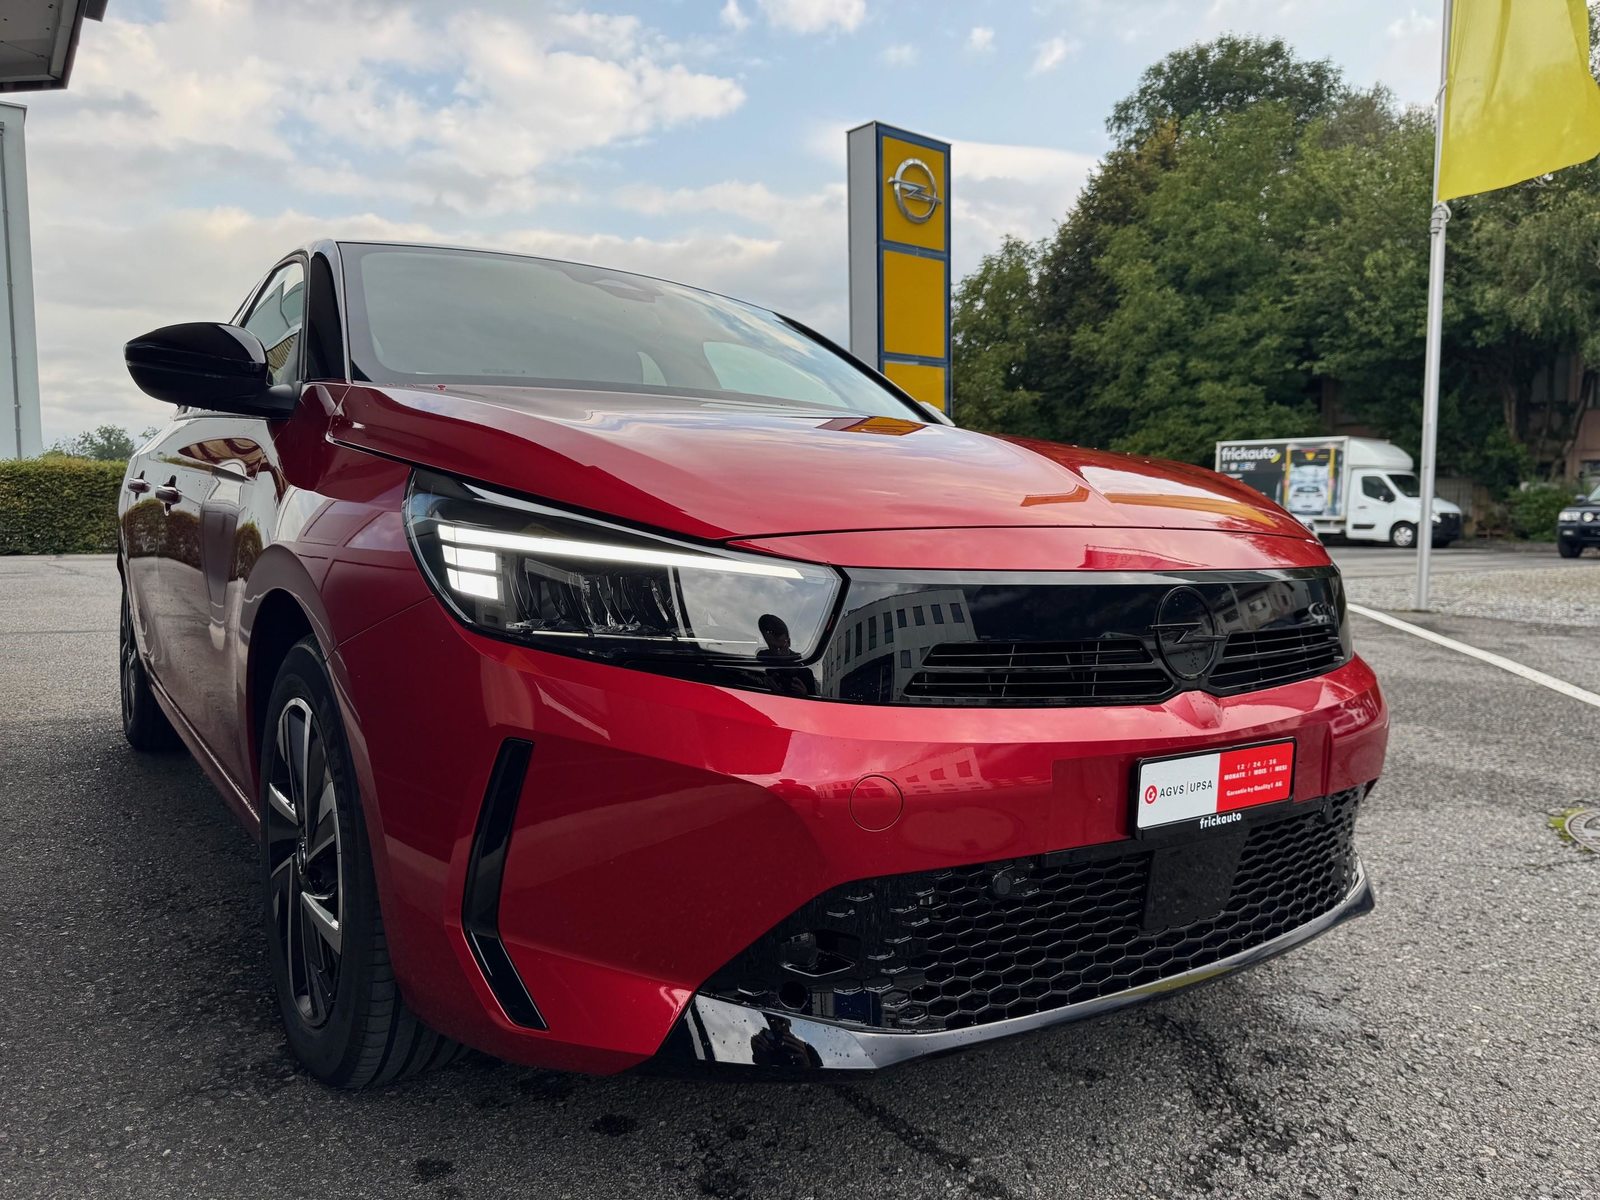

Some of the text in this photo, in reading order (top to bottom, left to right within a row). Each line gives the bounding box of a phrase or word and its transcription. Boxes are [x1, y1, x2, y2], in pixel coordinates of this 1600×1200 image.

[1222, 447, 1276, 461] frickauto
[1224, 772, 1246, 780] MONATE
[1160, 780, 1212, 798] AGVS UPSA
[1226, 788, 1247, 796] Garantie
[1200, 812, 1242, 829] frickauto
